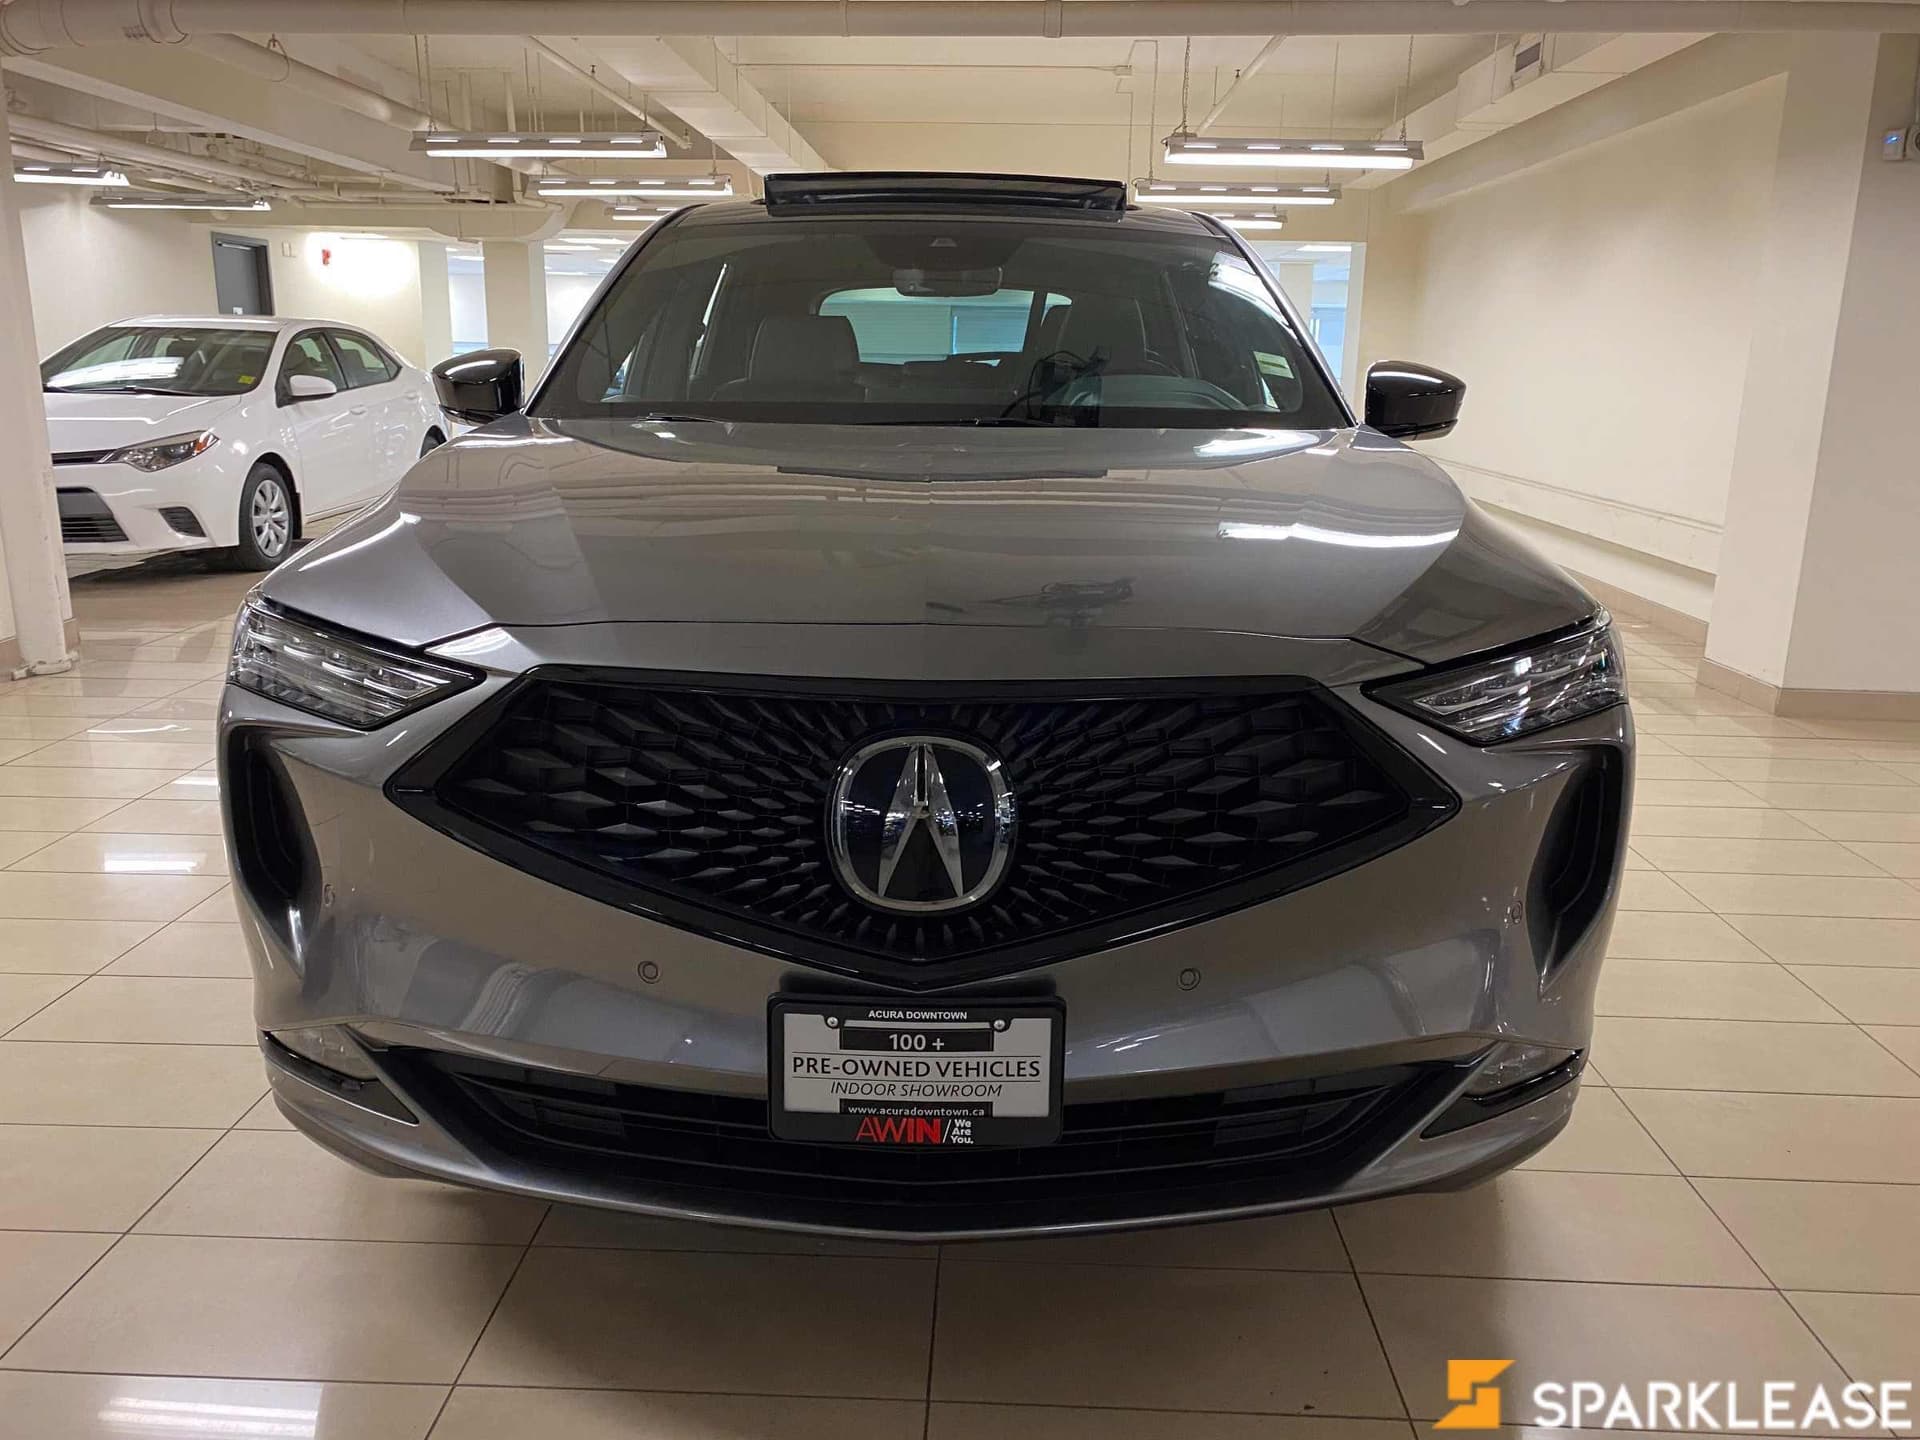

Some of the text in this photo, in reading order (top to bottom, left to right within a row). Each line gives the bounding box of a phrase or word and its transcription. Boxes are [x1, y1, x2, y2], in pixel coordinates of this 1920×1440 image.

[868, 1010, 968, 1020] ACURA DOWNTOWN
[889, 1034, 945, 1050] 100 +
[792, 1056, 1041, 1078] PRE-OWNED VEHICLES
[830, 1081, 1002, 1097] INDOOR SHOWROOM
[848, 1106, 985, 1116] www.acuradowntown.ca
[954, 1119, 972, 1128] We
[855, 1116, 943, 1144] AWIN
[952, 1128, 972, 1136] Are
[951, 1135, 974, 1144] You.
